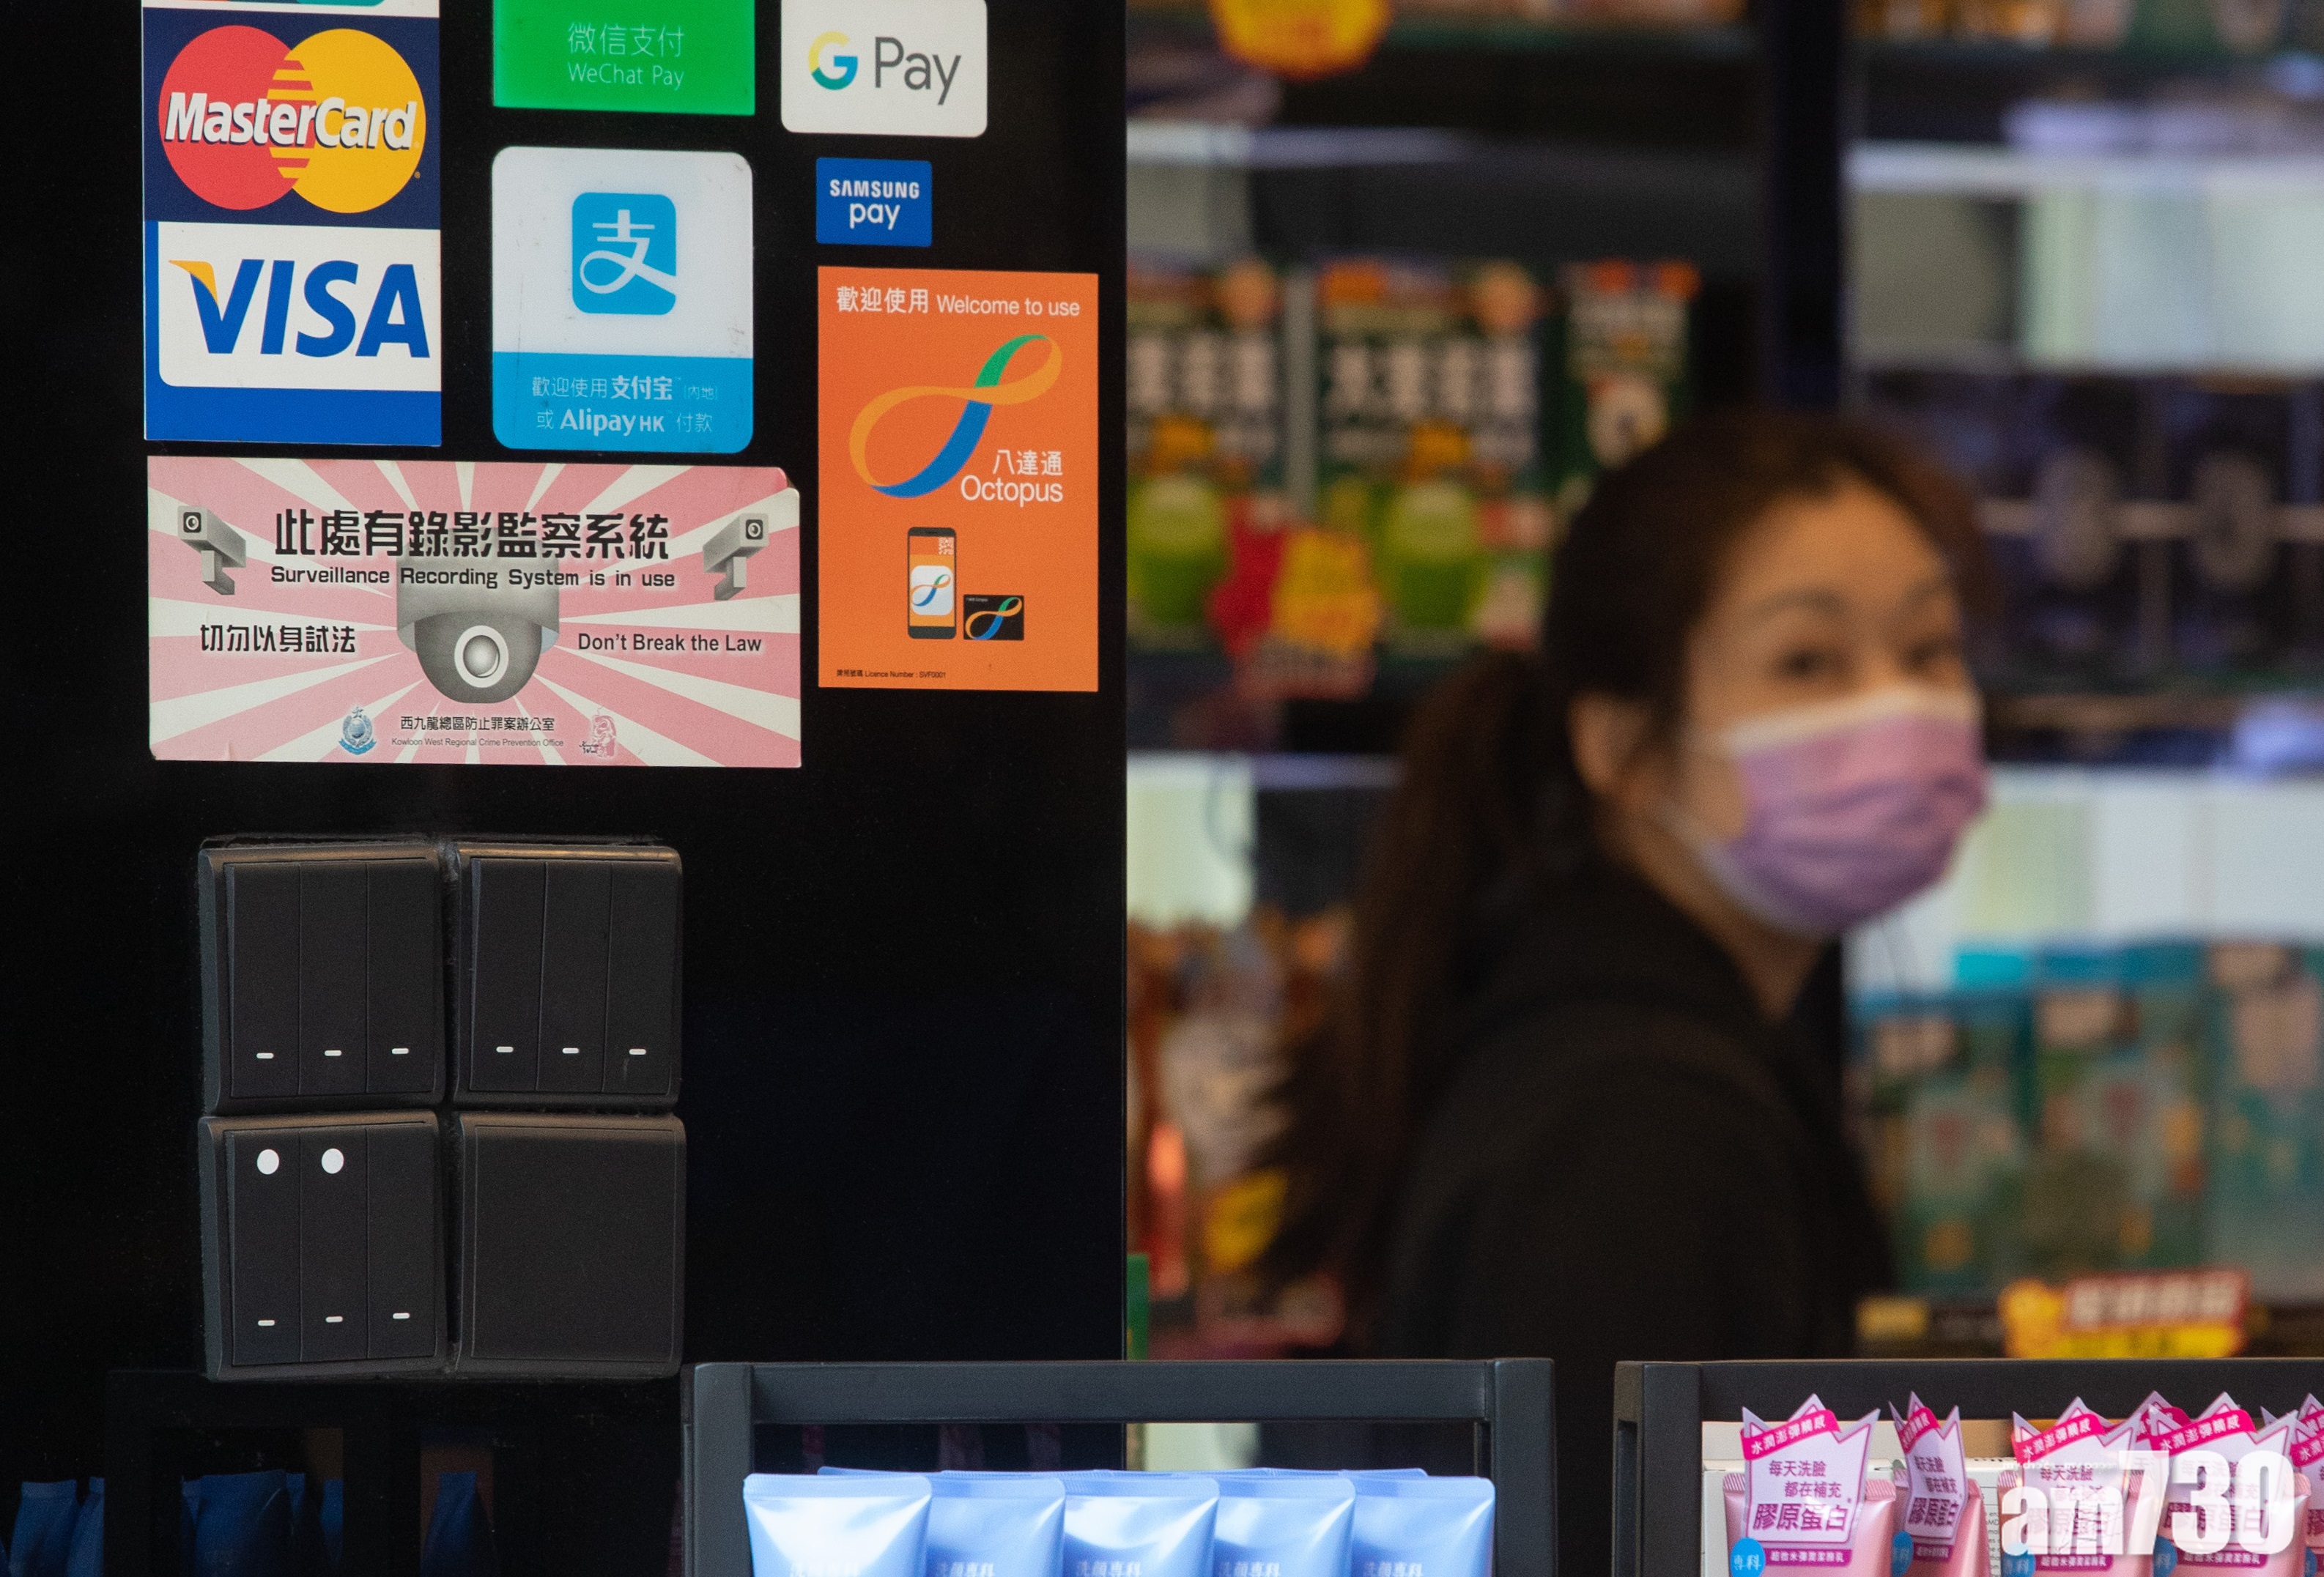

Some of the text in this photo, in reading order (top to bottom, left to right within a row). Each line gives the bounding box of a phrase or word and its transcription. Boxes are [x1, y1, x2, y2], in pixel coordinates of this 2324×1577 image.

[568, 23, 685, 56] 微信支付
[568, 62, 684, 91] WeChat Pay
[808, 31, 961, 105] G Pay
[165, 92, 418, 151] MasterCard
[829, 179, 920, 199] SAMSUNG
[850, 204, 900, 230] pay
[169, 259, 430, 357] VISA
[837, 286, 1080, 316] 歡迎使用 Welcome to use
[537, 409, 554, 430] 或
[676, 413, 713, 432] 付款
[993, 450, 1063, 476] 八達通
[961, 475, 1063, 508] Octopus
[275, 509, 668, 559] 此處有錄影監察系統
[271, 566, 675, 589] Surveillance Recording System is in use
[200, 624, 355, 653] 切勿以身試法
[578, 633, 762, 651] Don't Break the Law
[401, 716, 555, 731] 西九龍總區防止罪案辦公室
[391, 738, 423, 746] Kowloon
[445, 738, 477, 748] Regional
[479, 738, 500, 746] Crime
[503, 739, 541, 747] Prevention
[543, 739, 563, 747] Office
[1769, 1460, 1827, 1477] 每天洗臉
[1753, 1503, 1848, 1531] 膠原蛋白
